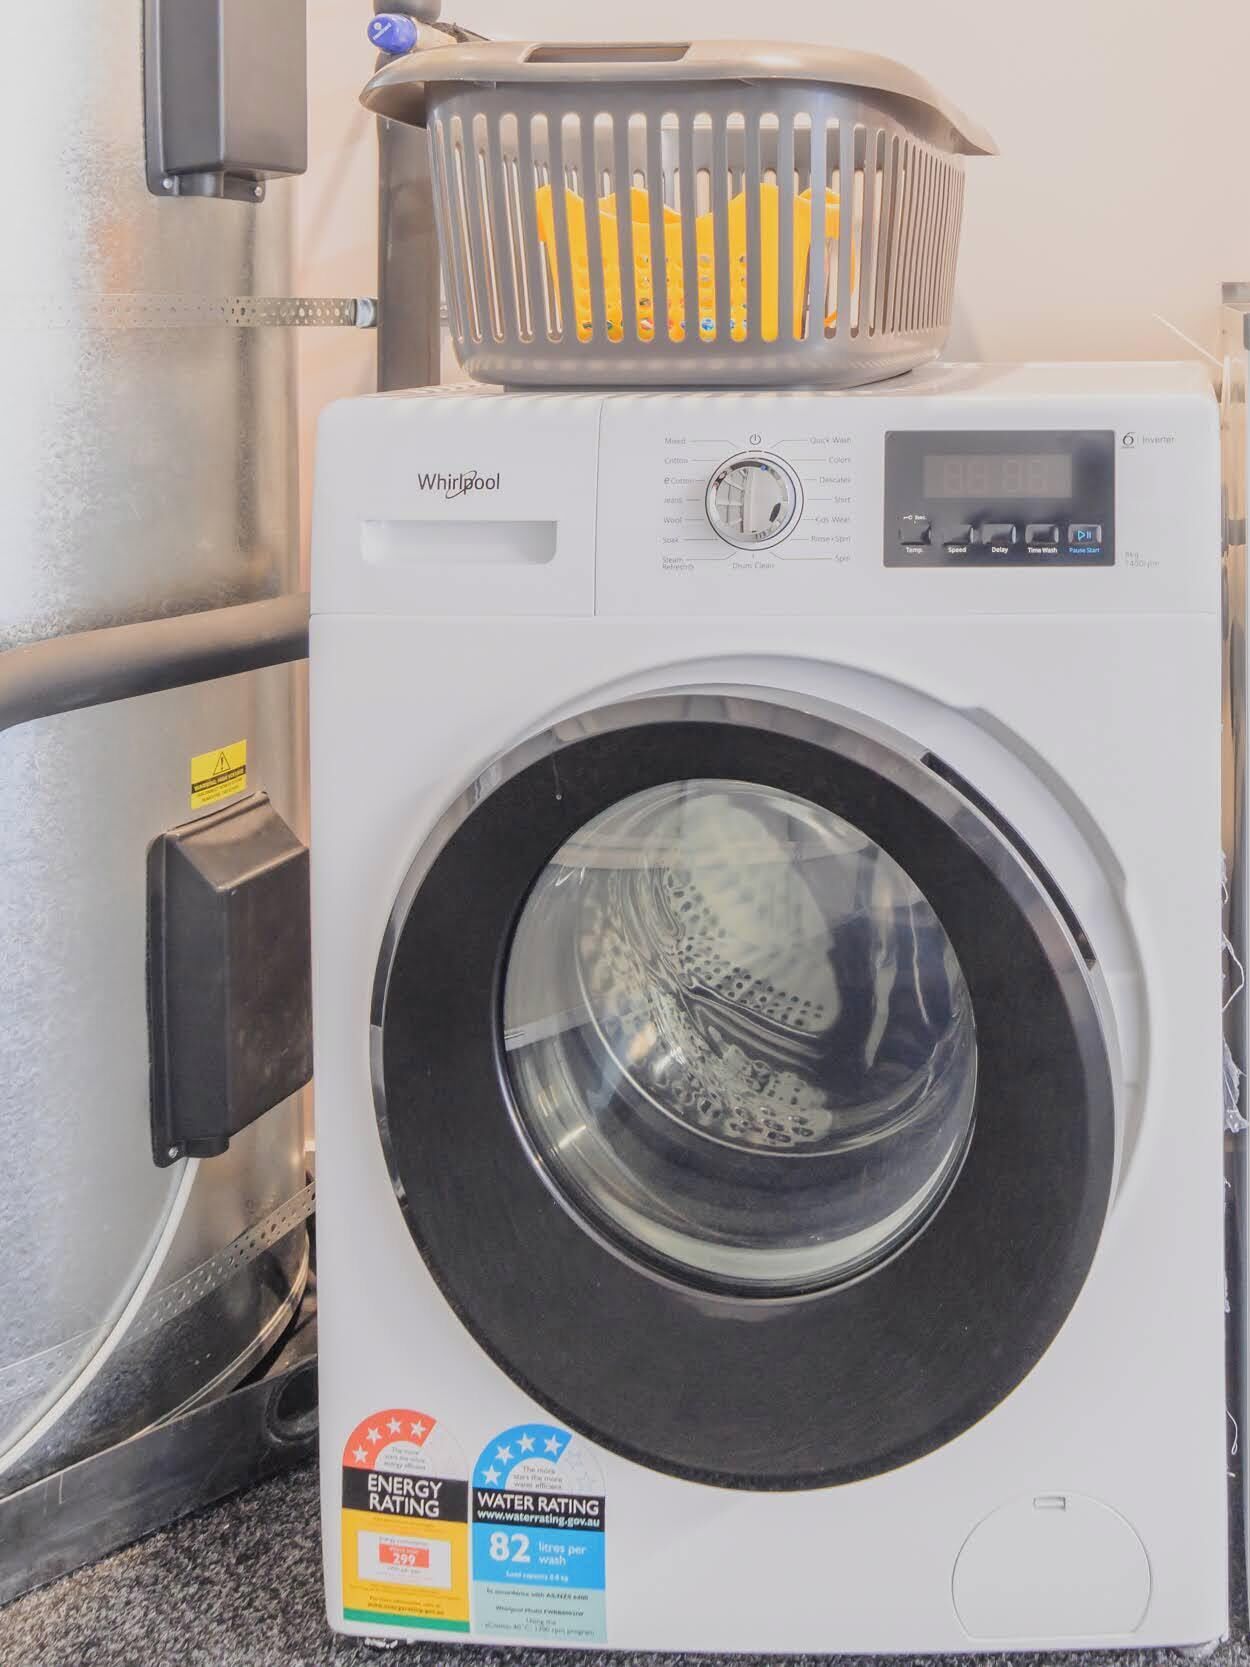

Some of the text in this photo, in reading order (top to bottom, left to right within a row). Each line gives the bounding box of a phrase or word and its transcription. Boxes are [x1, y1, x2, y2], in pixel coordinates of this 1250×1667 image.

[417, 470, 500, 498] Whirlpool
[948, 546, 967, 554] Speed
[991, 546, 1009, 554] Delay
[367, 1473, 442, 1499] ENERGY
[369, 1493, 440, 1518] RATING
[477, 1491, 599, 1516] WATER RATING
[477, 1510, 600, 1527] www.waterrating.gov.au
[489, 1531, 531, 1563] 82
[538, 1541, 587, 1556] litres per
[392, 1552, 416, 1567] 299
[539, 1555, 566, 1566] wash
